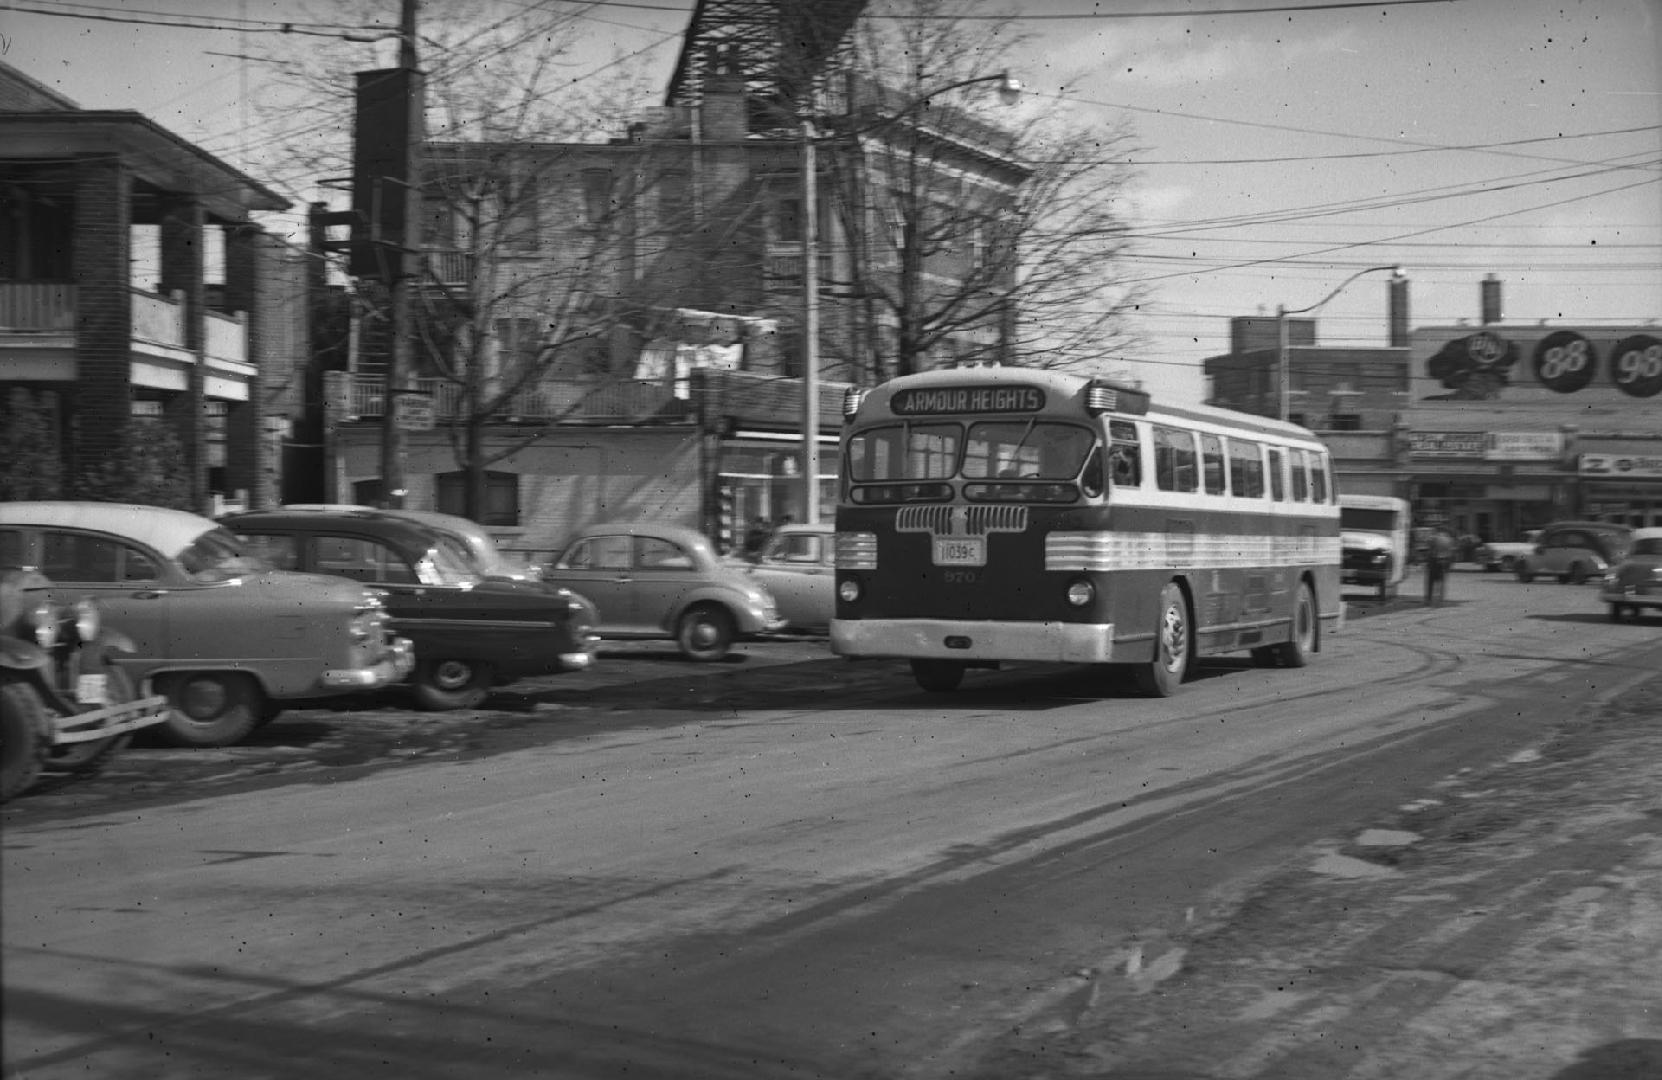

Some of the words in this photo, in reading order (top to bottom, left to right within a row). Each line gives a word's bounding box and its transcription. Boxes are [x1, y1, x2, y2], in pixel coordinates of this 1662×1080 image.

[1542, 340, 1587, 379] 88
[1617, 344, 1662, 384] 98
[904, 391, 967, 411] ARMOUR
[971, 389, 1038, 410] HEIGHTS
